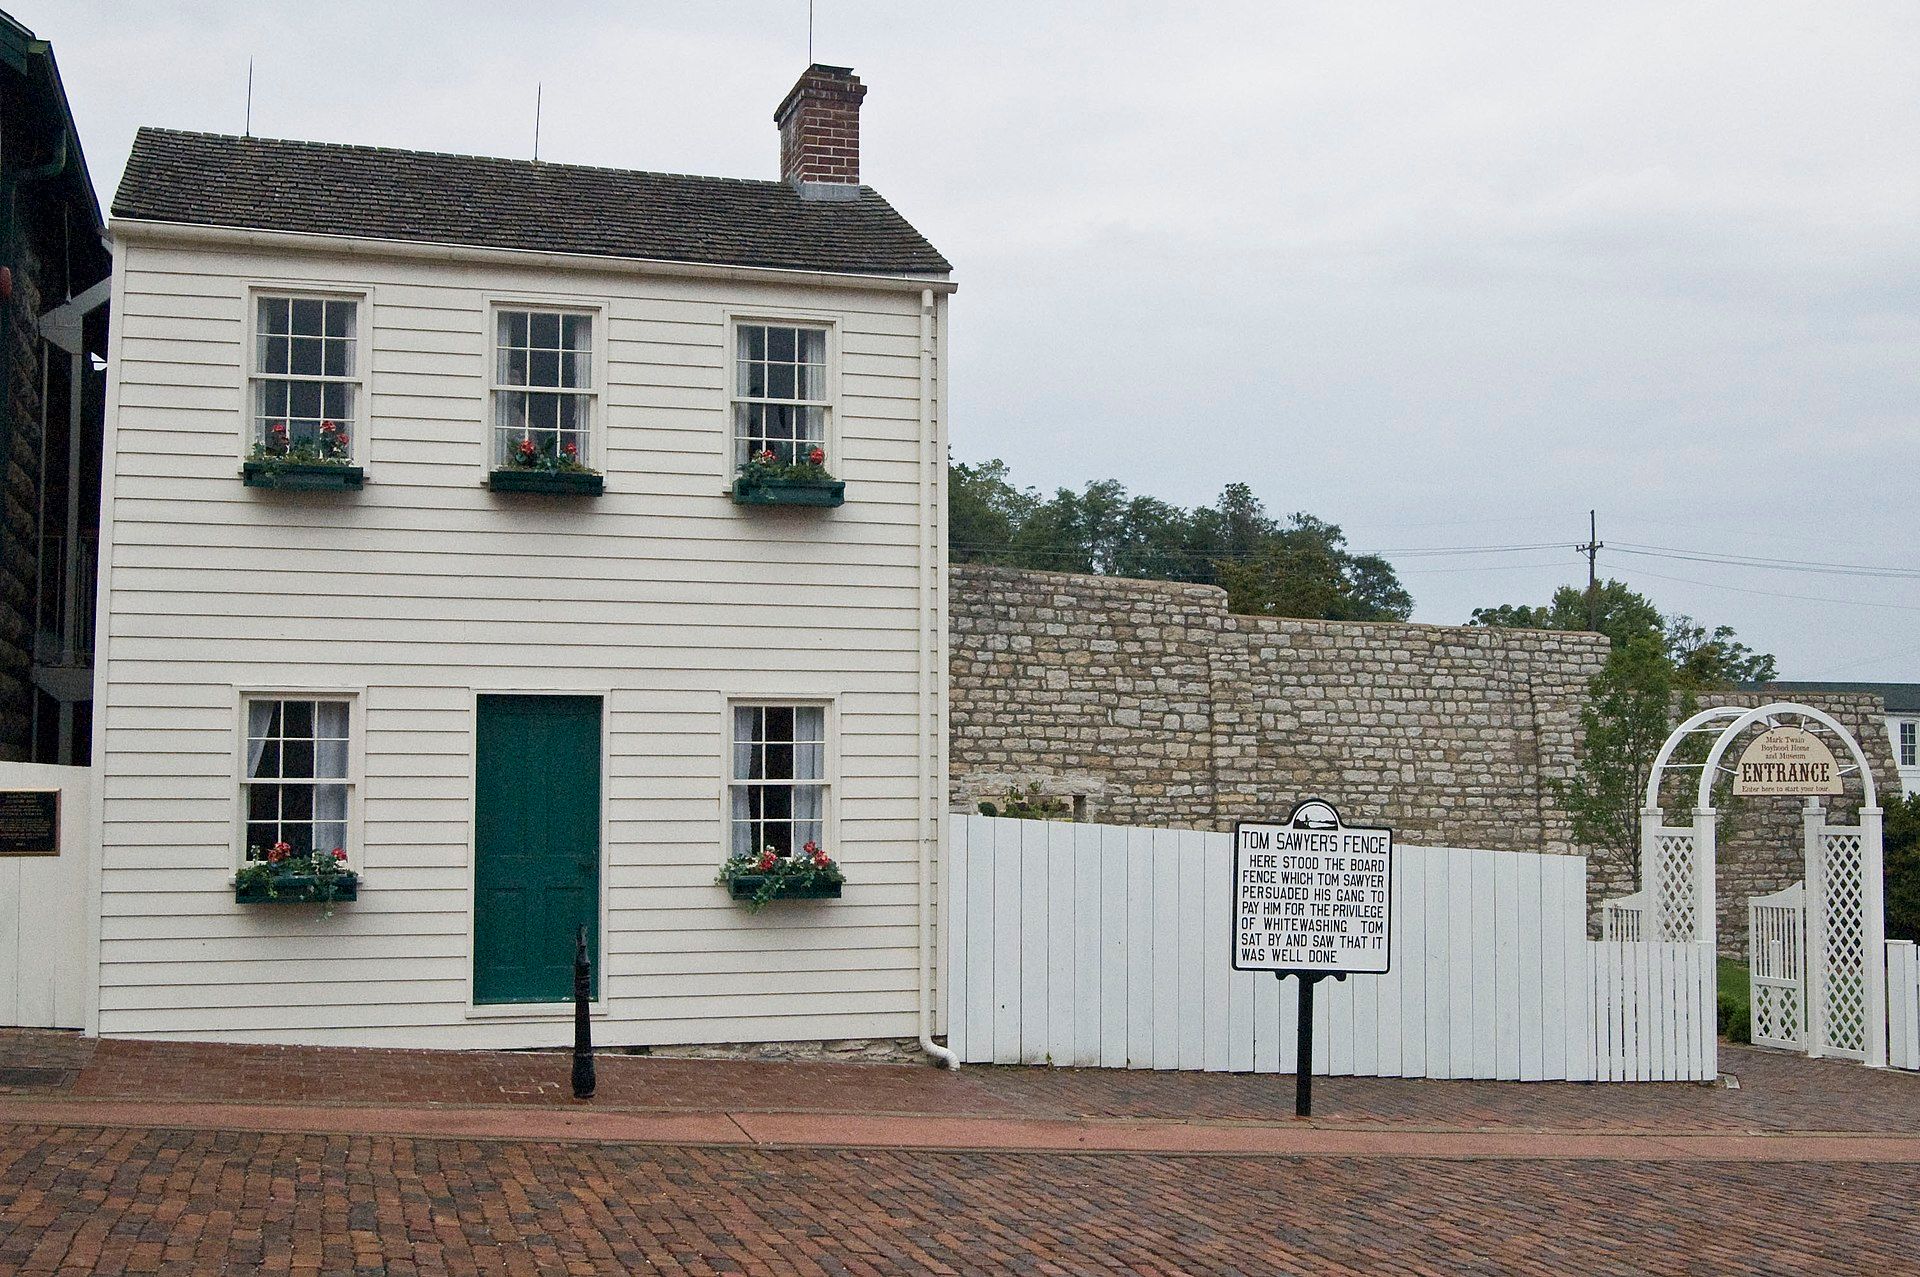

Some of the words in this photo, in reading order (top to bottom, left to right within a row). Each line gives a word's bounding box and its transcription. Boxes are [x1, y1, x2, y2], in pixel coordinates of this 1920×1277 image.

[1742, 763, 1829, 782] ENTRANCE
[1242, 831, 1269, 849] TOM
[1277, 832, 1337, 852] SAWYER'S
[1344, 835, 1386, 854] FENCE
[1250, 855, 1277, 868] HERE
[1283, 856, 1318, 869] STOOD
[1325, 858, 1345, 870] THE
[1351, 859, 1384, 872] BOARD
[1242, 870, 1276, 883] FENCE
[1281, 872, 1313, 885] WHICH
[1318, 873, 1339, 886] TOM
[1344, 874, 1384, 887] SAWYER
[1242, 886, 1308, 900] PERSUADED
[1315, 889, 1331, 900] HIS
[1337, 889, 1364, 902] GANG
[1371, 890, 1384, 903] TO
[1242, 902, 1259, 914] PAY
[1263, 902, 1280, 915] HIM
[1285, 903, 1304, 916] FOR
[1310, 904, 1330, 916] THE
[1333, 905, 1383, 918] PRIVILEGE
[1242, 917, 1256, 930] OF
[1264, 918, 1347, 932] WHITEWASHING
[1361, 921, 1383, 934] TOM
[1242, 933, 1262, 946] SAT
[1269, 934, 1281, 946] BY
[1286, 934, 1307, 946] AND
[1313, 935, 1334, 948] SAW
[1340, 936, 1368, 948] THAT
[1372, 937, 1383, 949] IT
[1242, 949, 1265, 961] WAS
[1272, 950, 1303, 962] WELL
